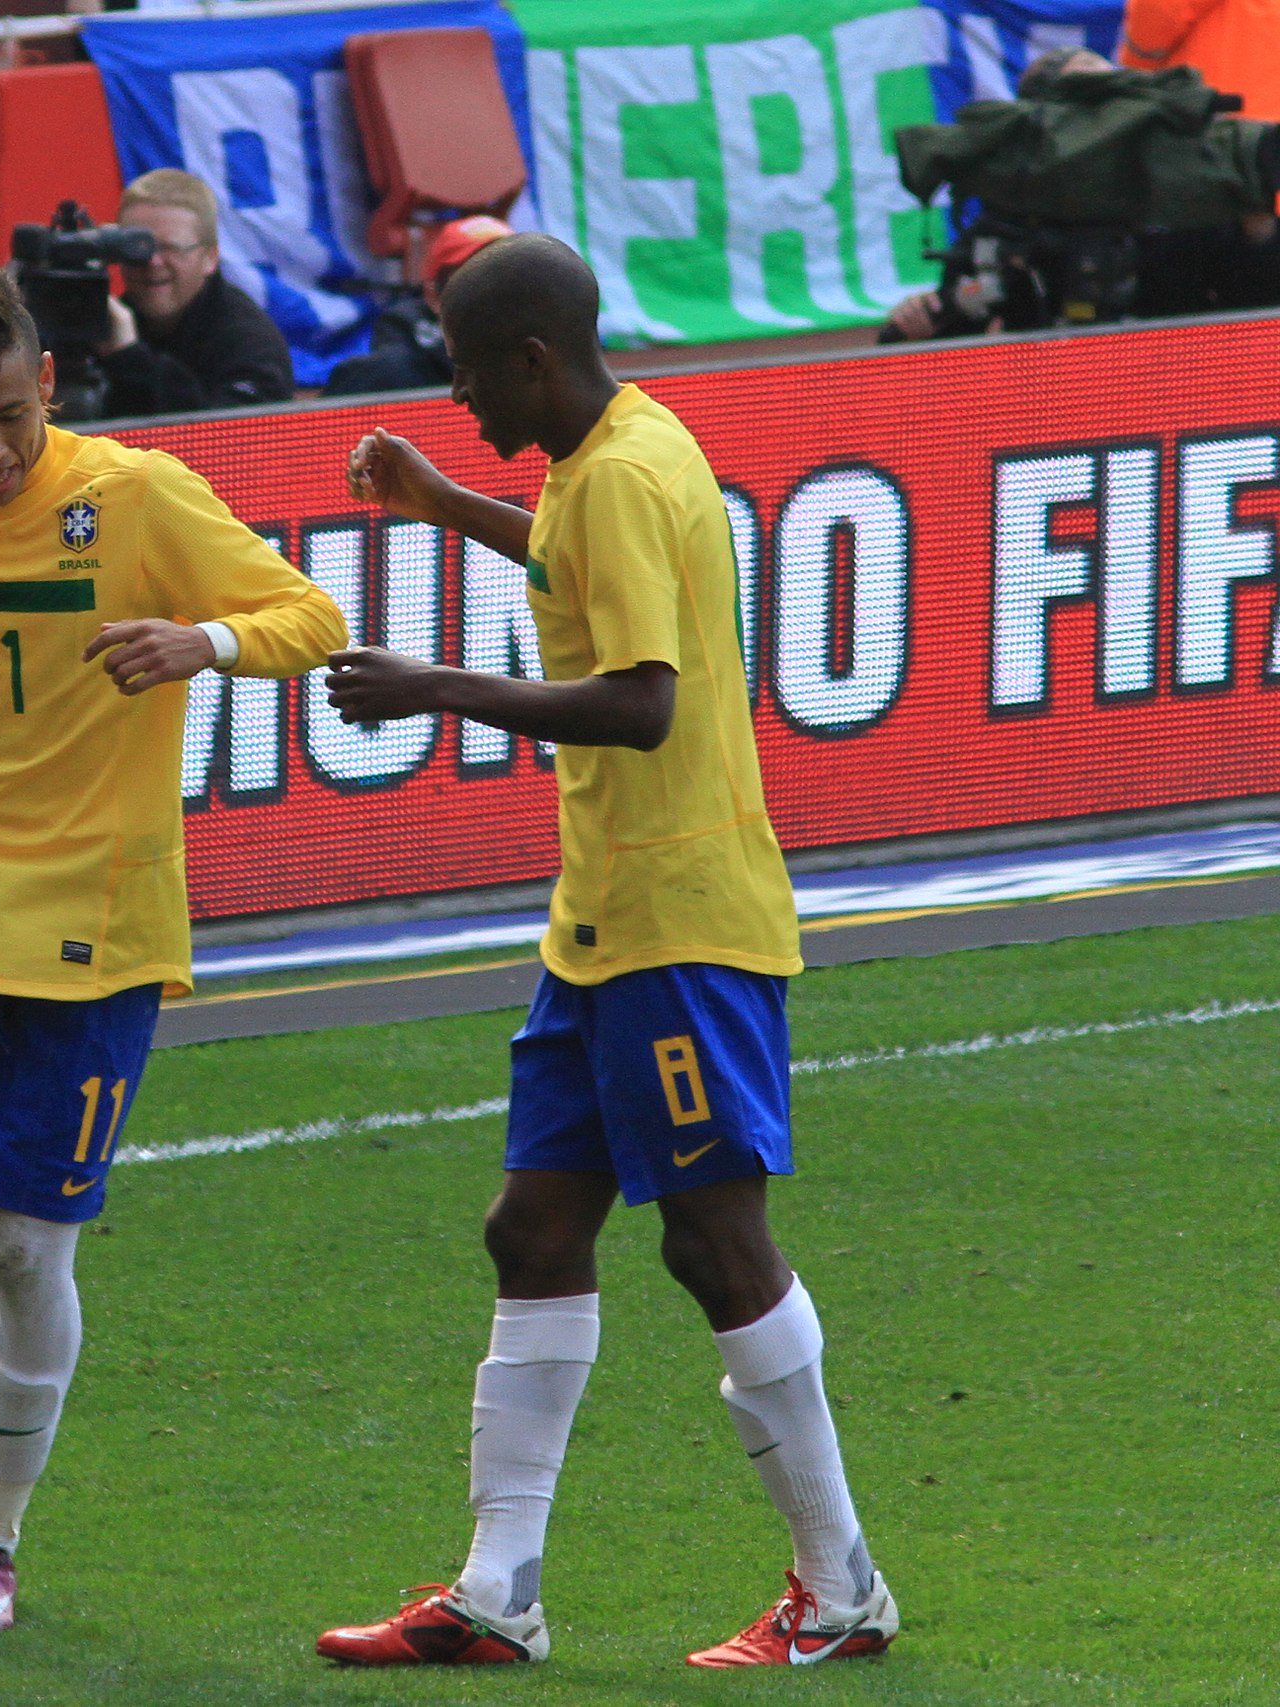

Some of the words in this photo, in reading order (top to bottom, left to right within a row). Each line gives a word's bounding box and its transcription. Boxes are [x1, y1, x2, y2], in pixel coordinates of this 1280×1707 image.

[58, 558, 102, 570] BRASIL
[991, 434, 1280, 706] FIF
[73, 1075, 127, 1164] 11
[652, 1034, 712, 1127] 8
